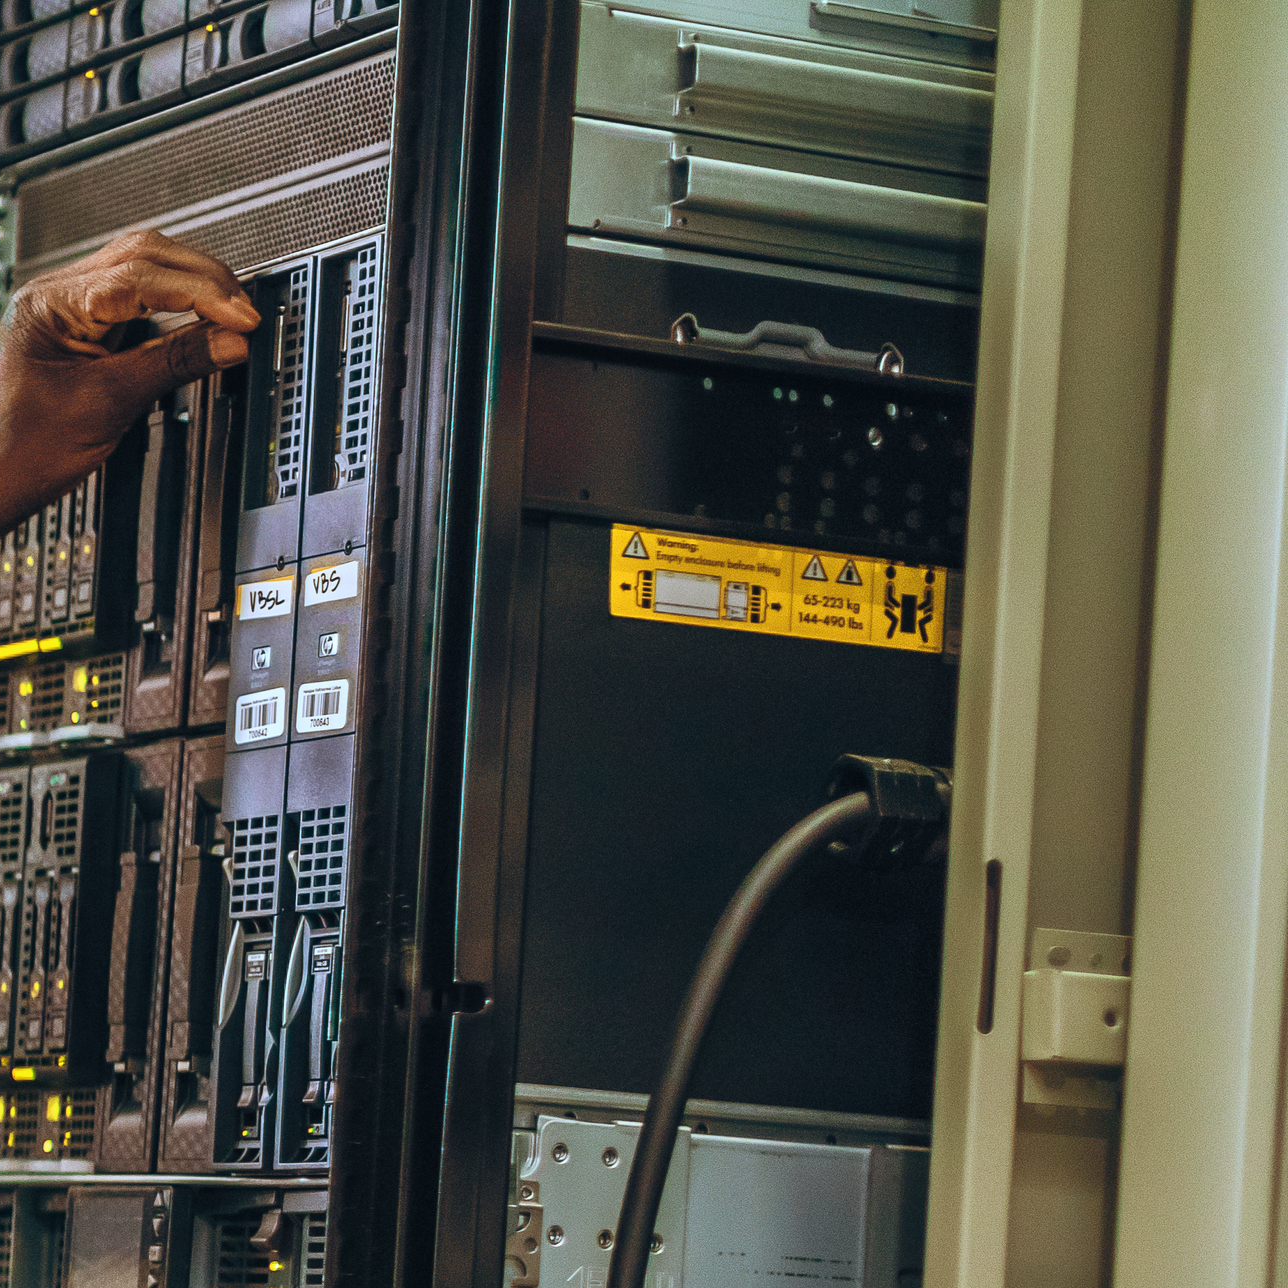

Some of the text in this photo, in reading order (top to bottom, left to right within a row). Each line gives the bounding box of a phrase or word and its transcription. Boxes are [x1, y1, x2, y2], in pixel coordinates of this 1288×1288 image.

[657, 537, 699, 553] Warning:
[656, 550, 781, 577] Empty enclosure before lifting
[804, 594, 861, 614] 65-223 kg
[798, 611, 864, 630] 144-490 lbs
